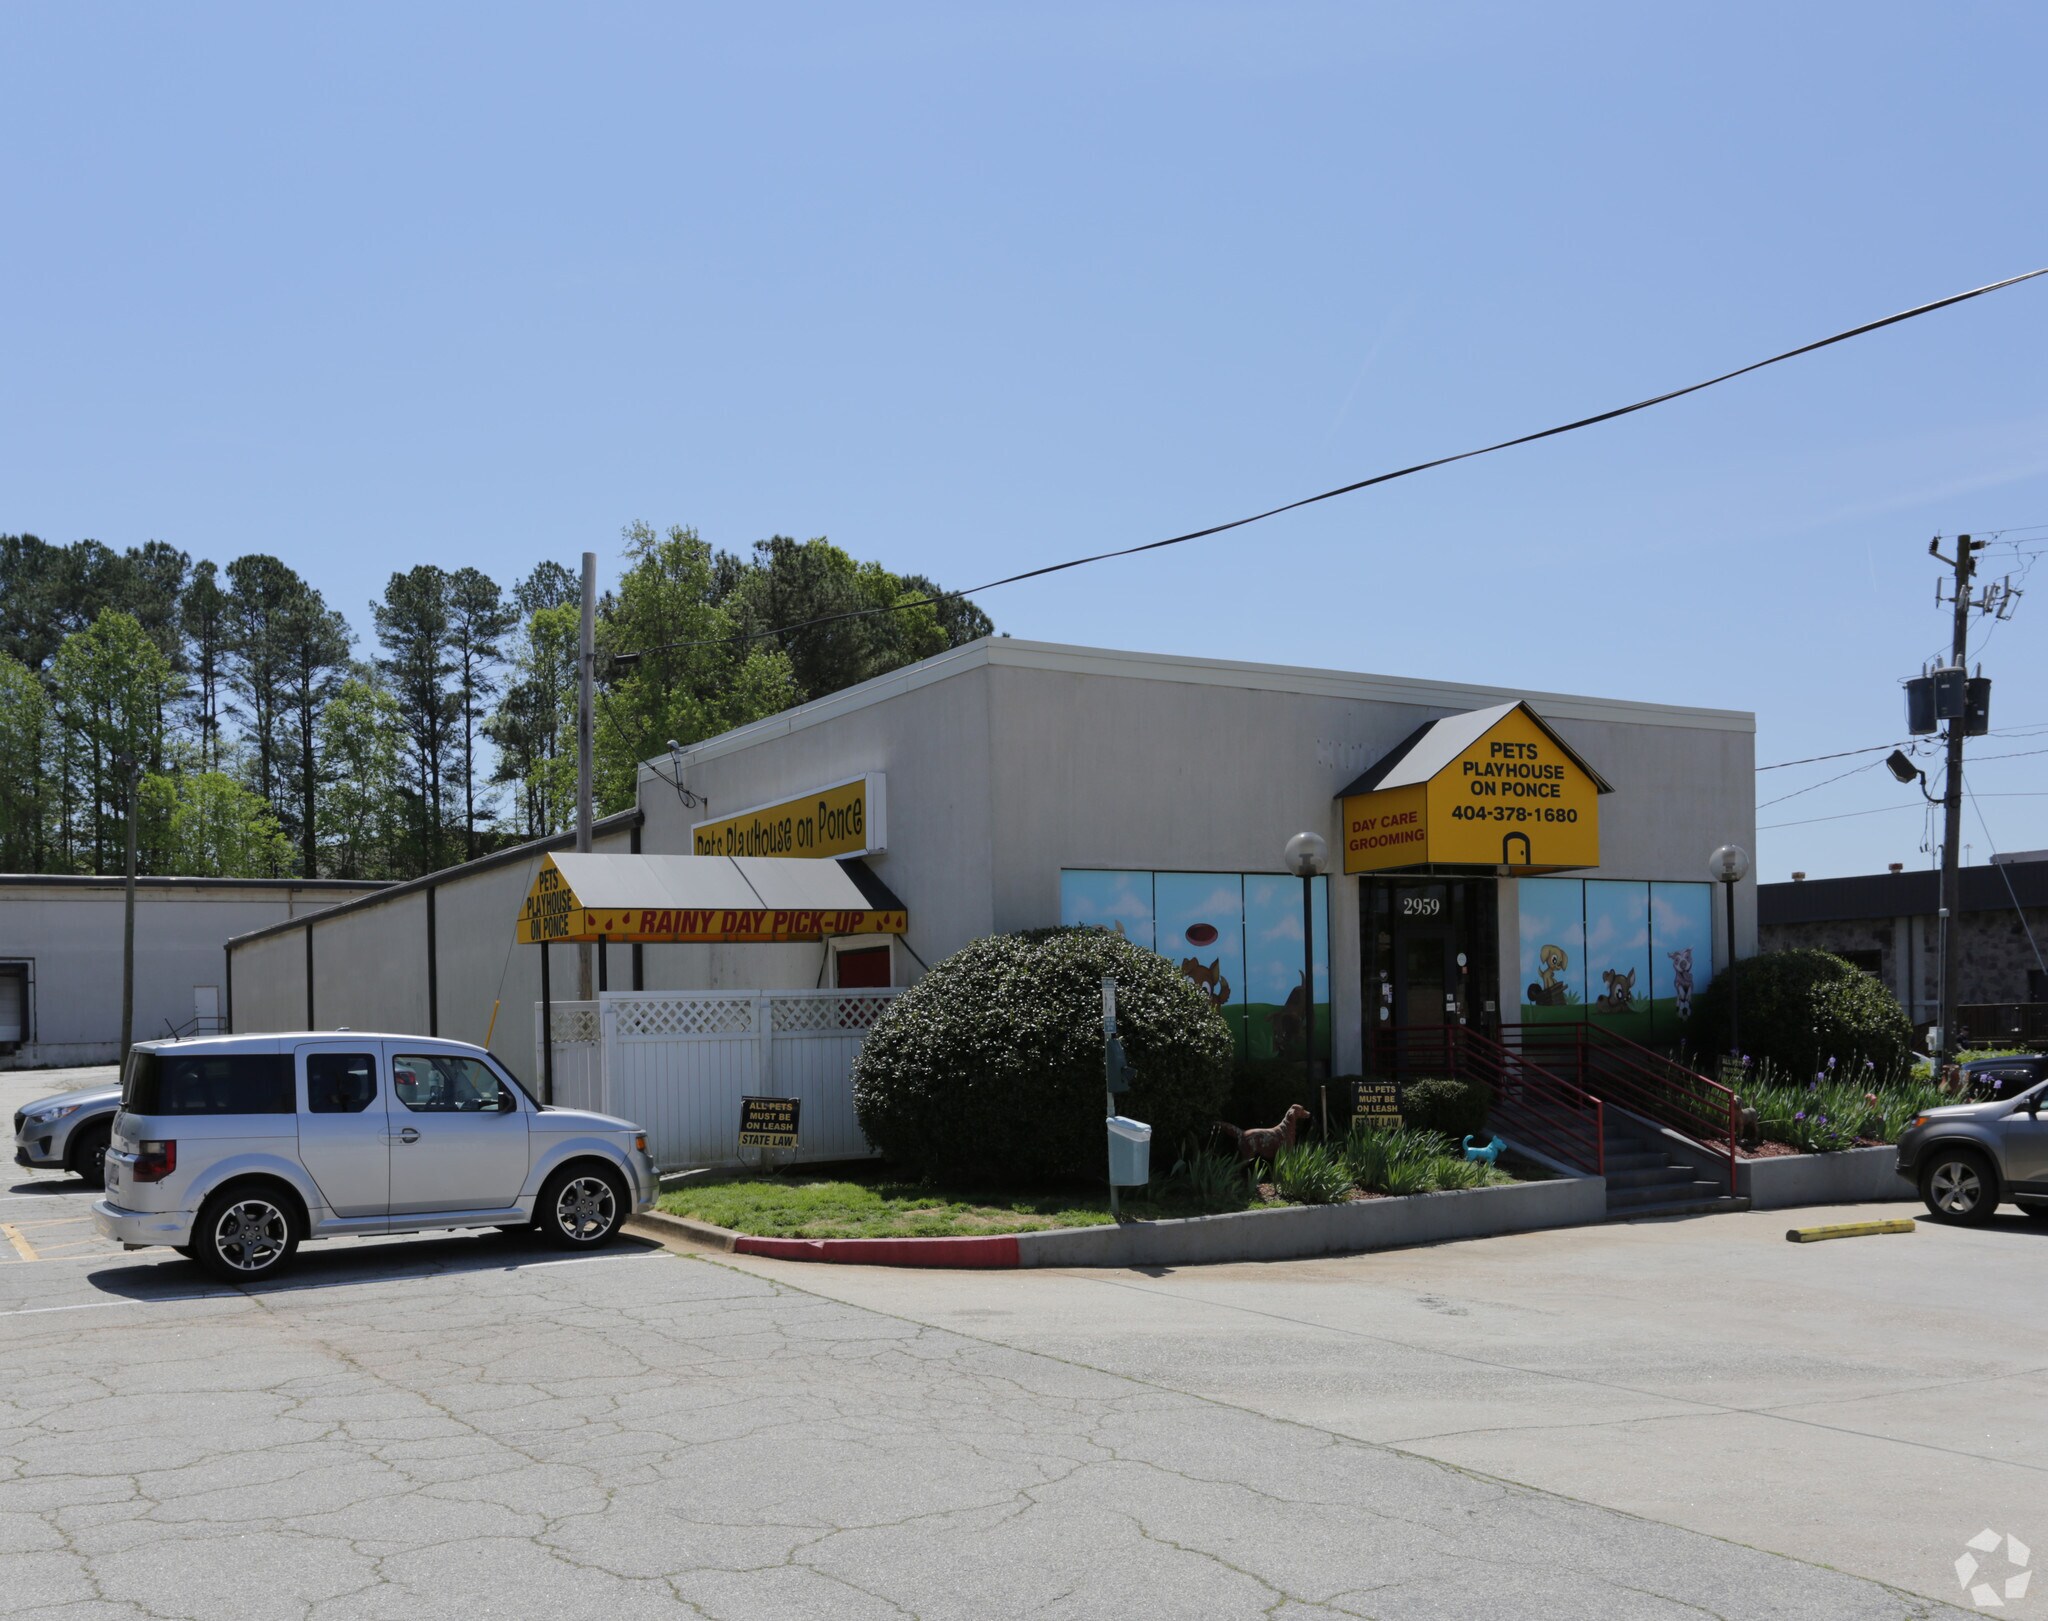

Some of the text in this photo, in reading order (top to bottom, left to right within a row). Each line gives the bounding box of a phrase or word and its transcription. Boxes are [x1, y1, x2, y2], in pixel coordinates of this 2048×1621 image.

[1490, 742, 1538, 760] PETS
[1463, 761, 1564, 780] PLAYHOUSE
[1470, 780, 1561, 798] ON PONCE
[796, 816, 813, 849] on
[818, 797, 863, 844] Ponce
[1352, 811, 1418, 834] DAY CARE
[1451, 805, 1578, 824] 404-378-1680
[1349, 828, 1425, 852] GROOMING
[538, 868, 559, 893] PETS
[526, 888, 573, 919] PLAYHOUSE
[1403, 898, 1441, 916] 2959
[530, 913, 569, 941] ON PONCE
[638, 910, 865, 934] RAINY DAY PICK-UP
[1359, 1095, 1395, 1103] MUST BE
[763, 1122, 793, 1131] LEASH
[779, 1113, 791, 1121] BE
[742, 1134, 793, 1146] STATE LAW
